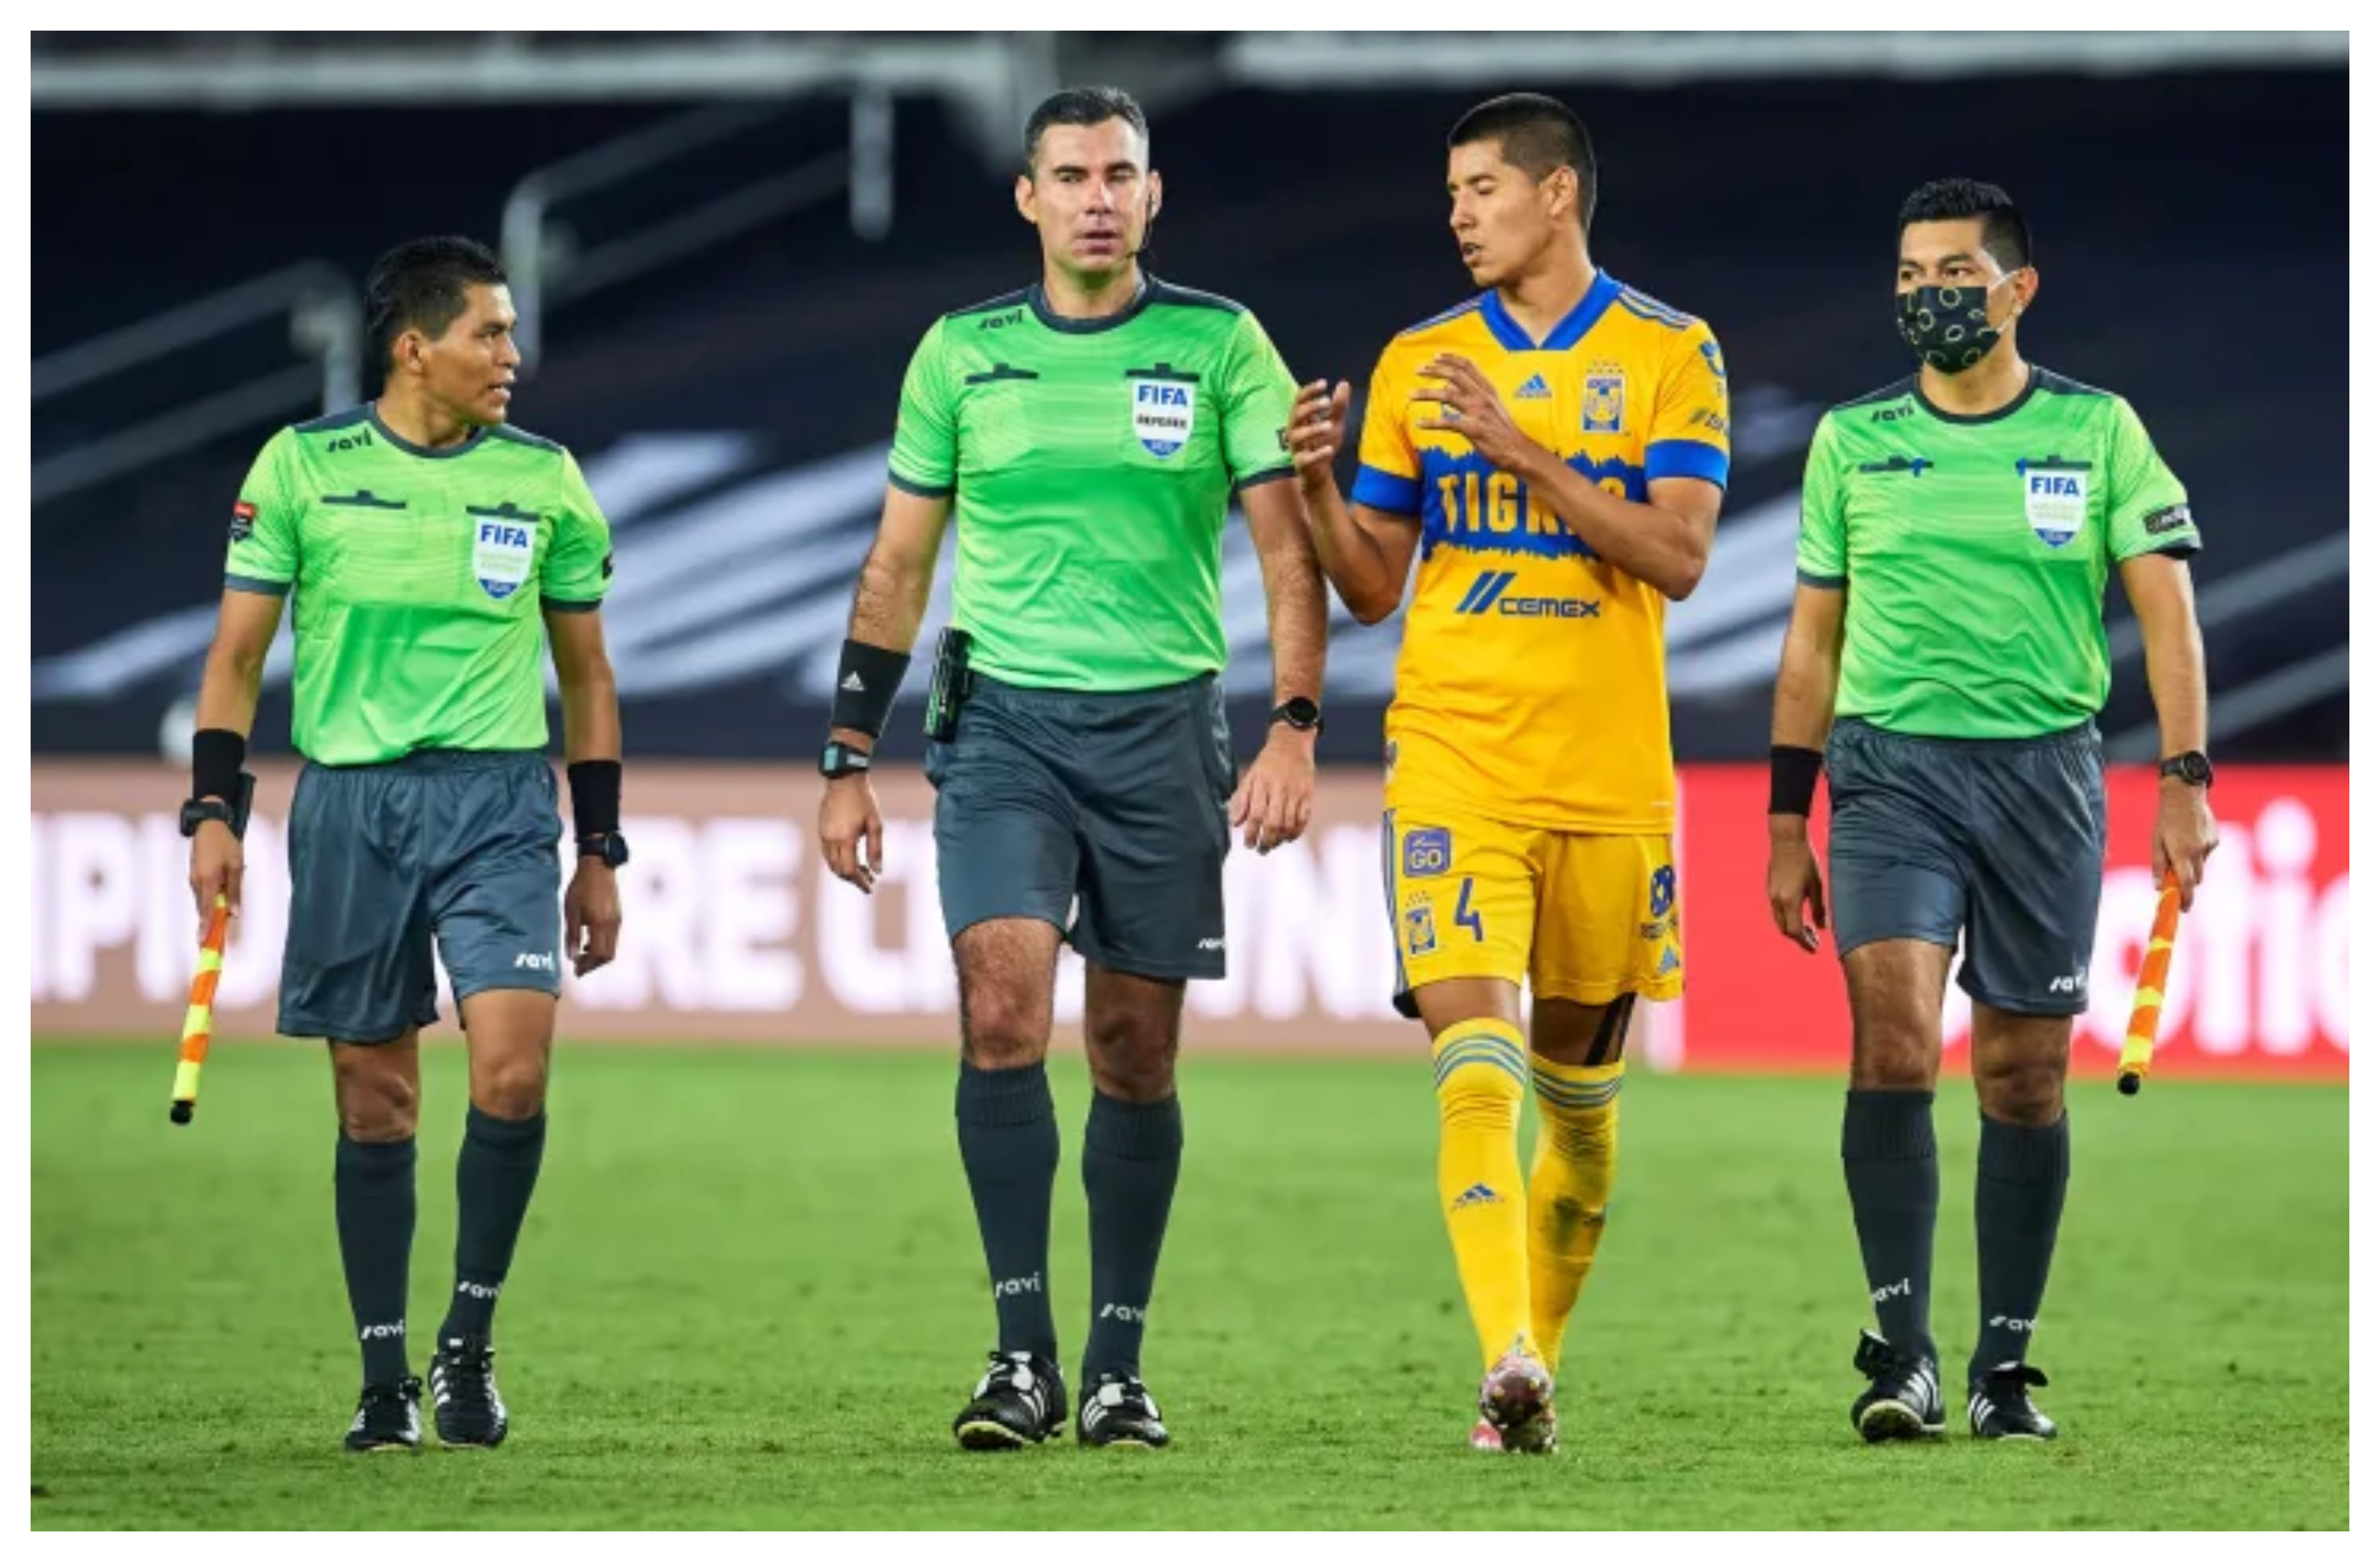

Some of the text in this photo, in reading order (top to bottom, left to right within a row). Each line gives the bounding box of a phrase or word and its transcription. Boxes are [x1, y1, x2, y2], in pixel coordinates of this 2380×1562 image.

[1138, 385, 1187, 405] FIFA
[2031, 477, 2080, 497] FIFA
[481, 524, 527, 548] FIFA
[1498, 597, 1601, 618] CEMEX
[1409, 848, 1442, 869] GO
[1455, 877, 1485, 942] 4
